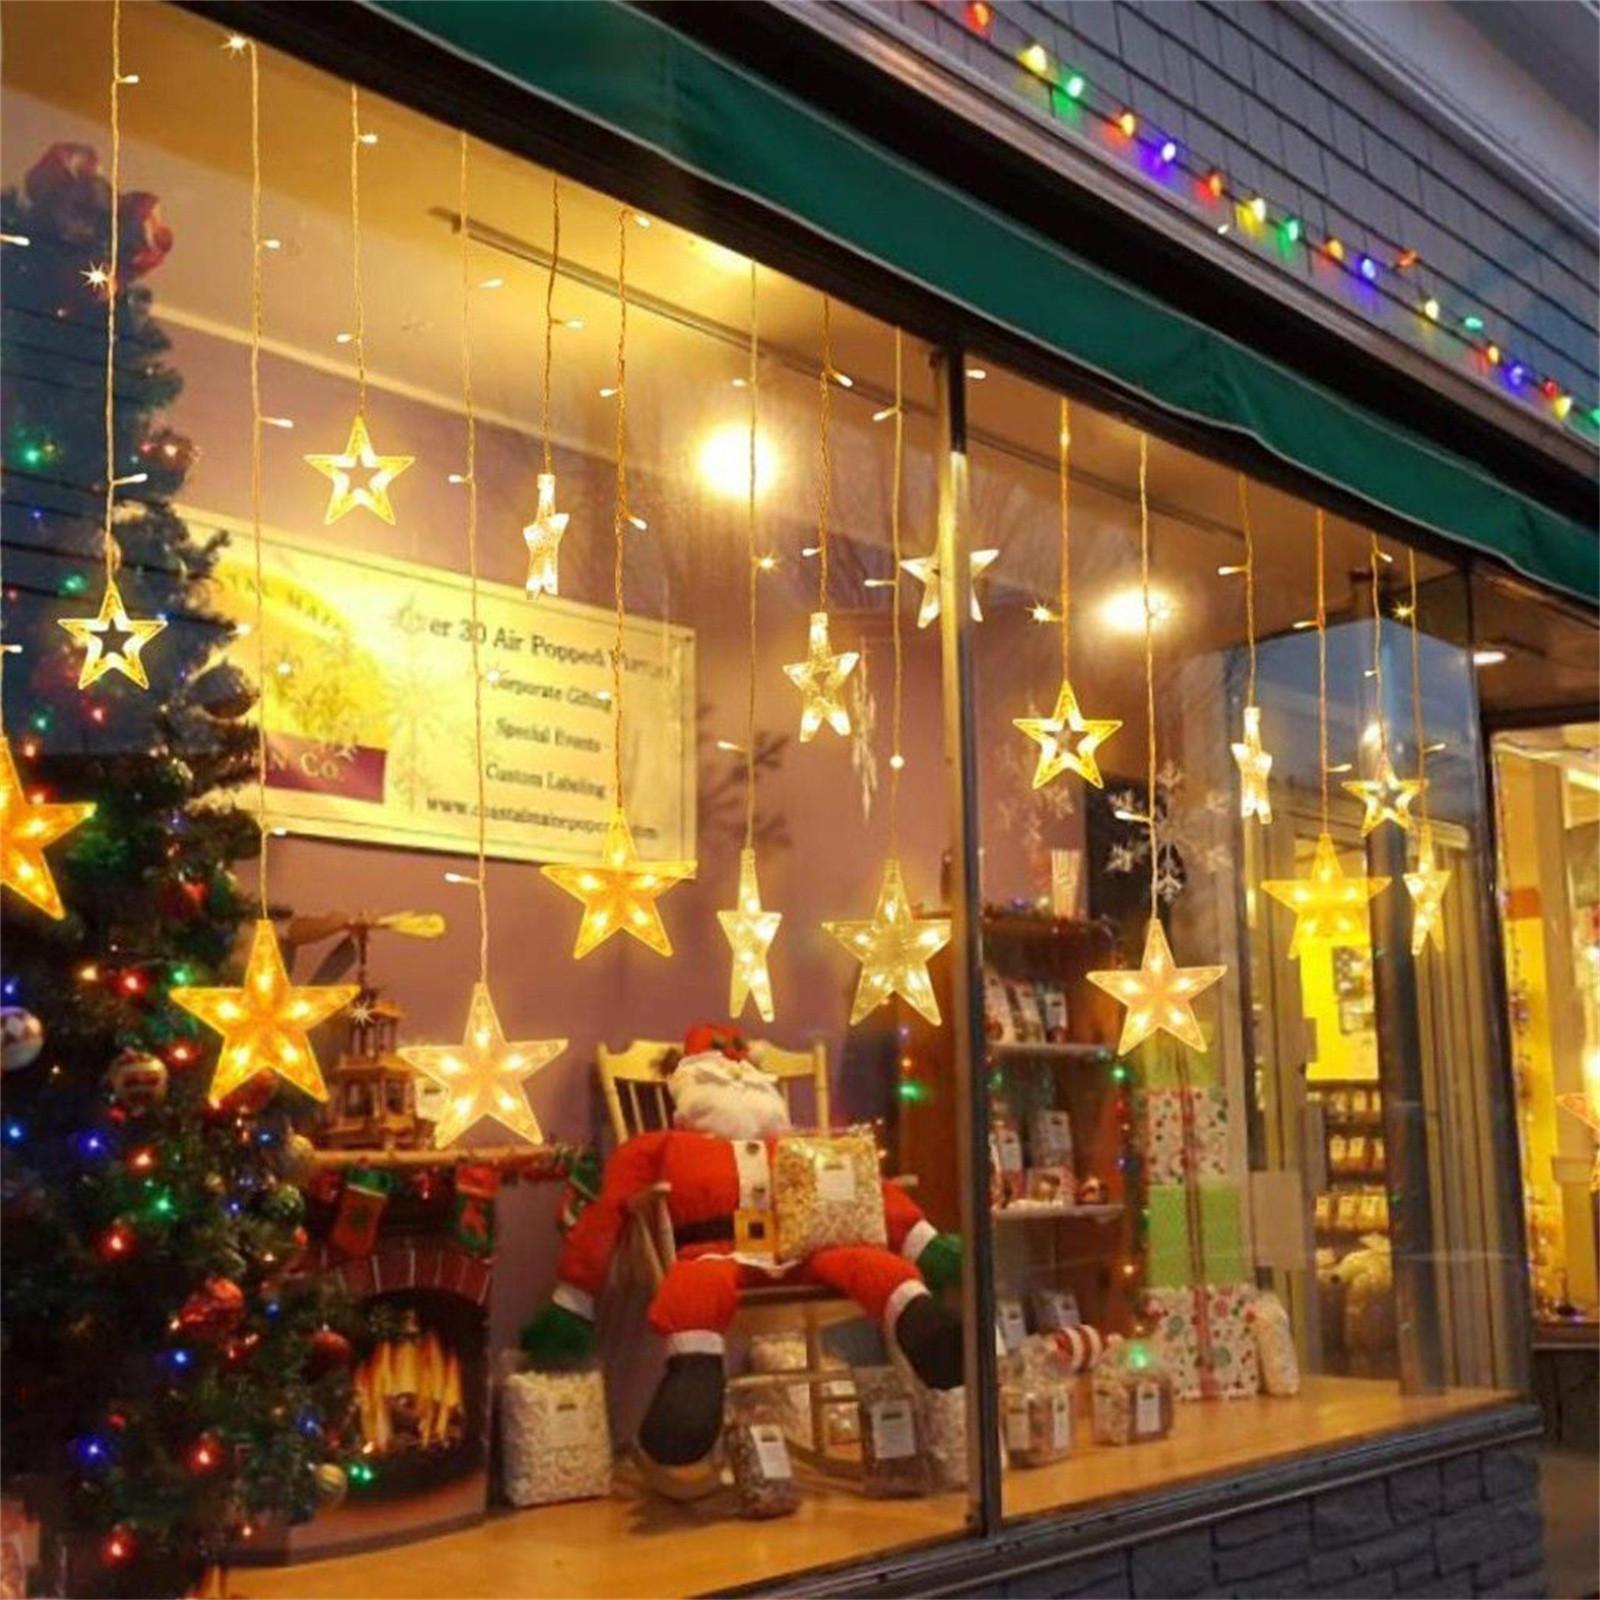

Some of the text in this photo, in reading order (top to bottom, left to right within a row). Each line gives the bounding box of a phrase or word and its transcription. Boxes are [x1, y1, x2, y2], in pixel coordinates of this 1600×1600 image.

[493, 627, 525, 653] Air
[530, 634, 606, 668] Popped
[496, 717, 600, 752] Special Events
[485, 762, 606, 799] Custom Labeling
